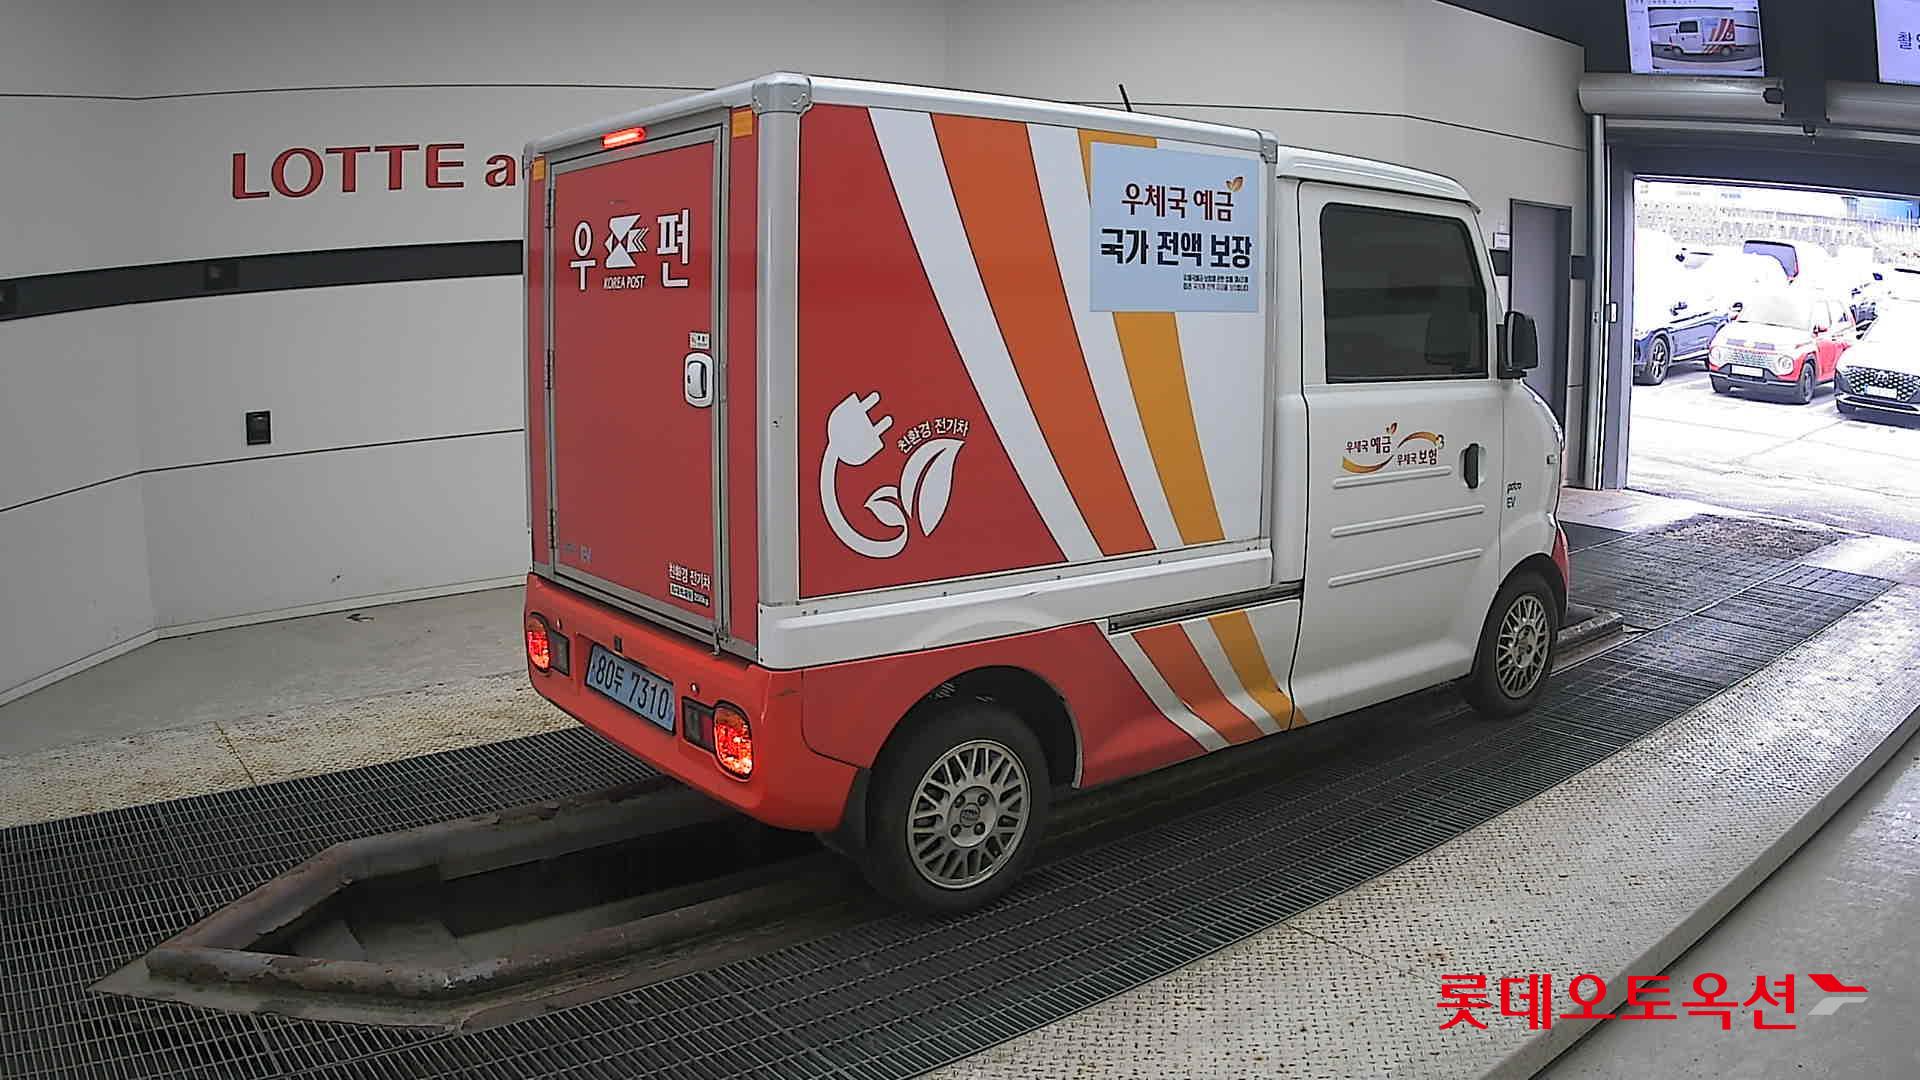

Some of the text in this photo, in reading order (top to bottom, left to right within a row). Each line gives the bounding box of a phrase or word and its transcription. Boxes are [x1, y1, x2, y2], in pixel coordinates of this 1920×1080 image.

[231, 143, 517, 200] LOTTE a
[1121, 183, 1235, 222] 우체국 예금
[1100, 227, 1252, 269] 국가 전액 보장
[603, 274, 646, 290] KOREA POST
[898, 417, 969, 454] 친환경 전기차
[1345, 436, 1392, 454] 우체국 예금
[1418, 448, 1438, 466] 보험
[628, 671, 670, 720] 7310
